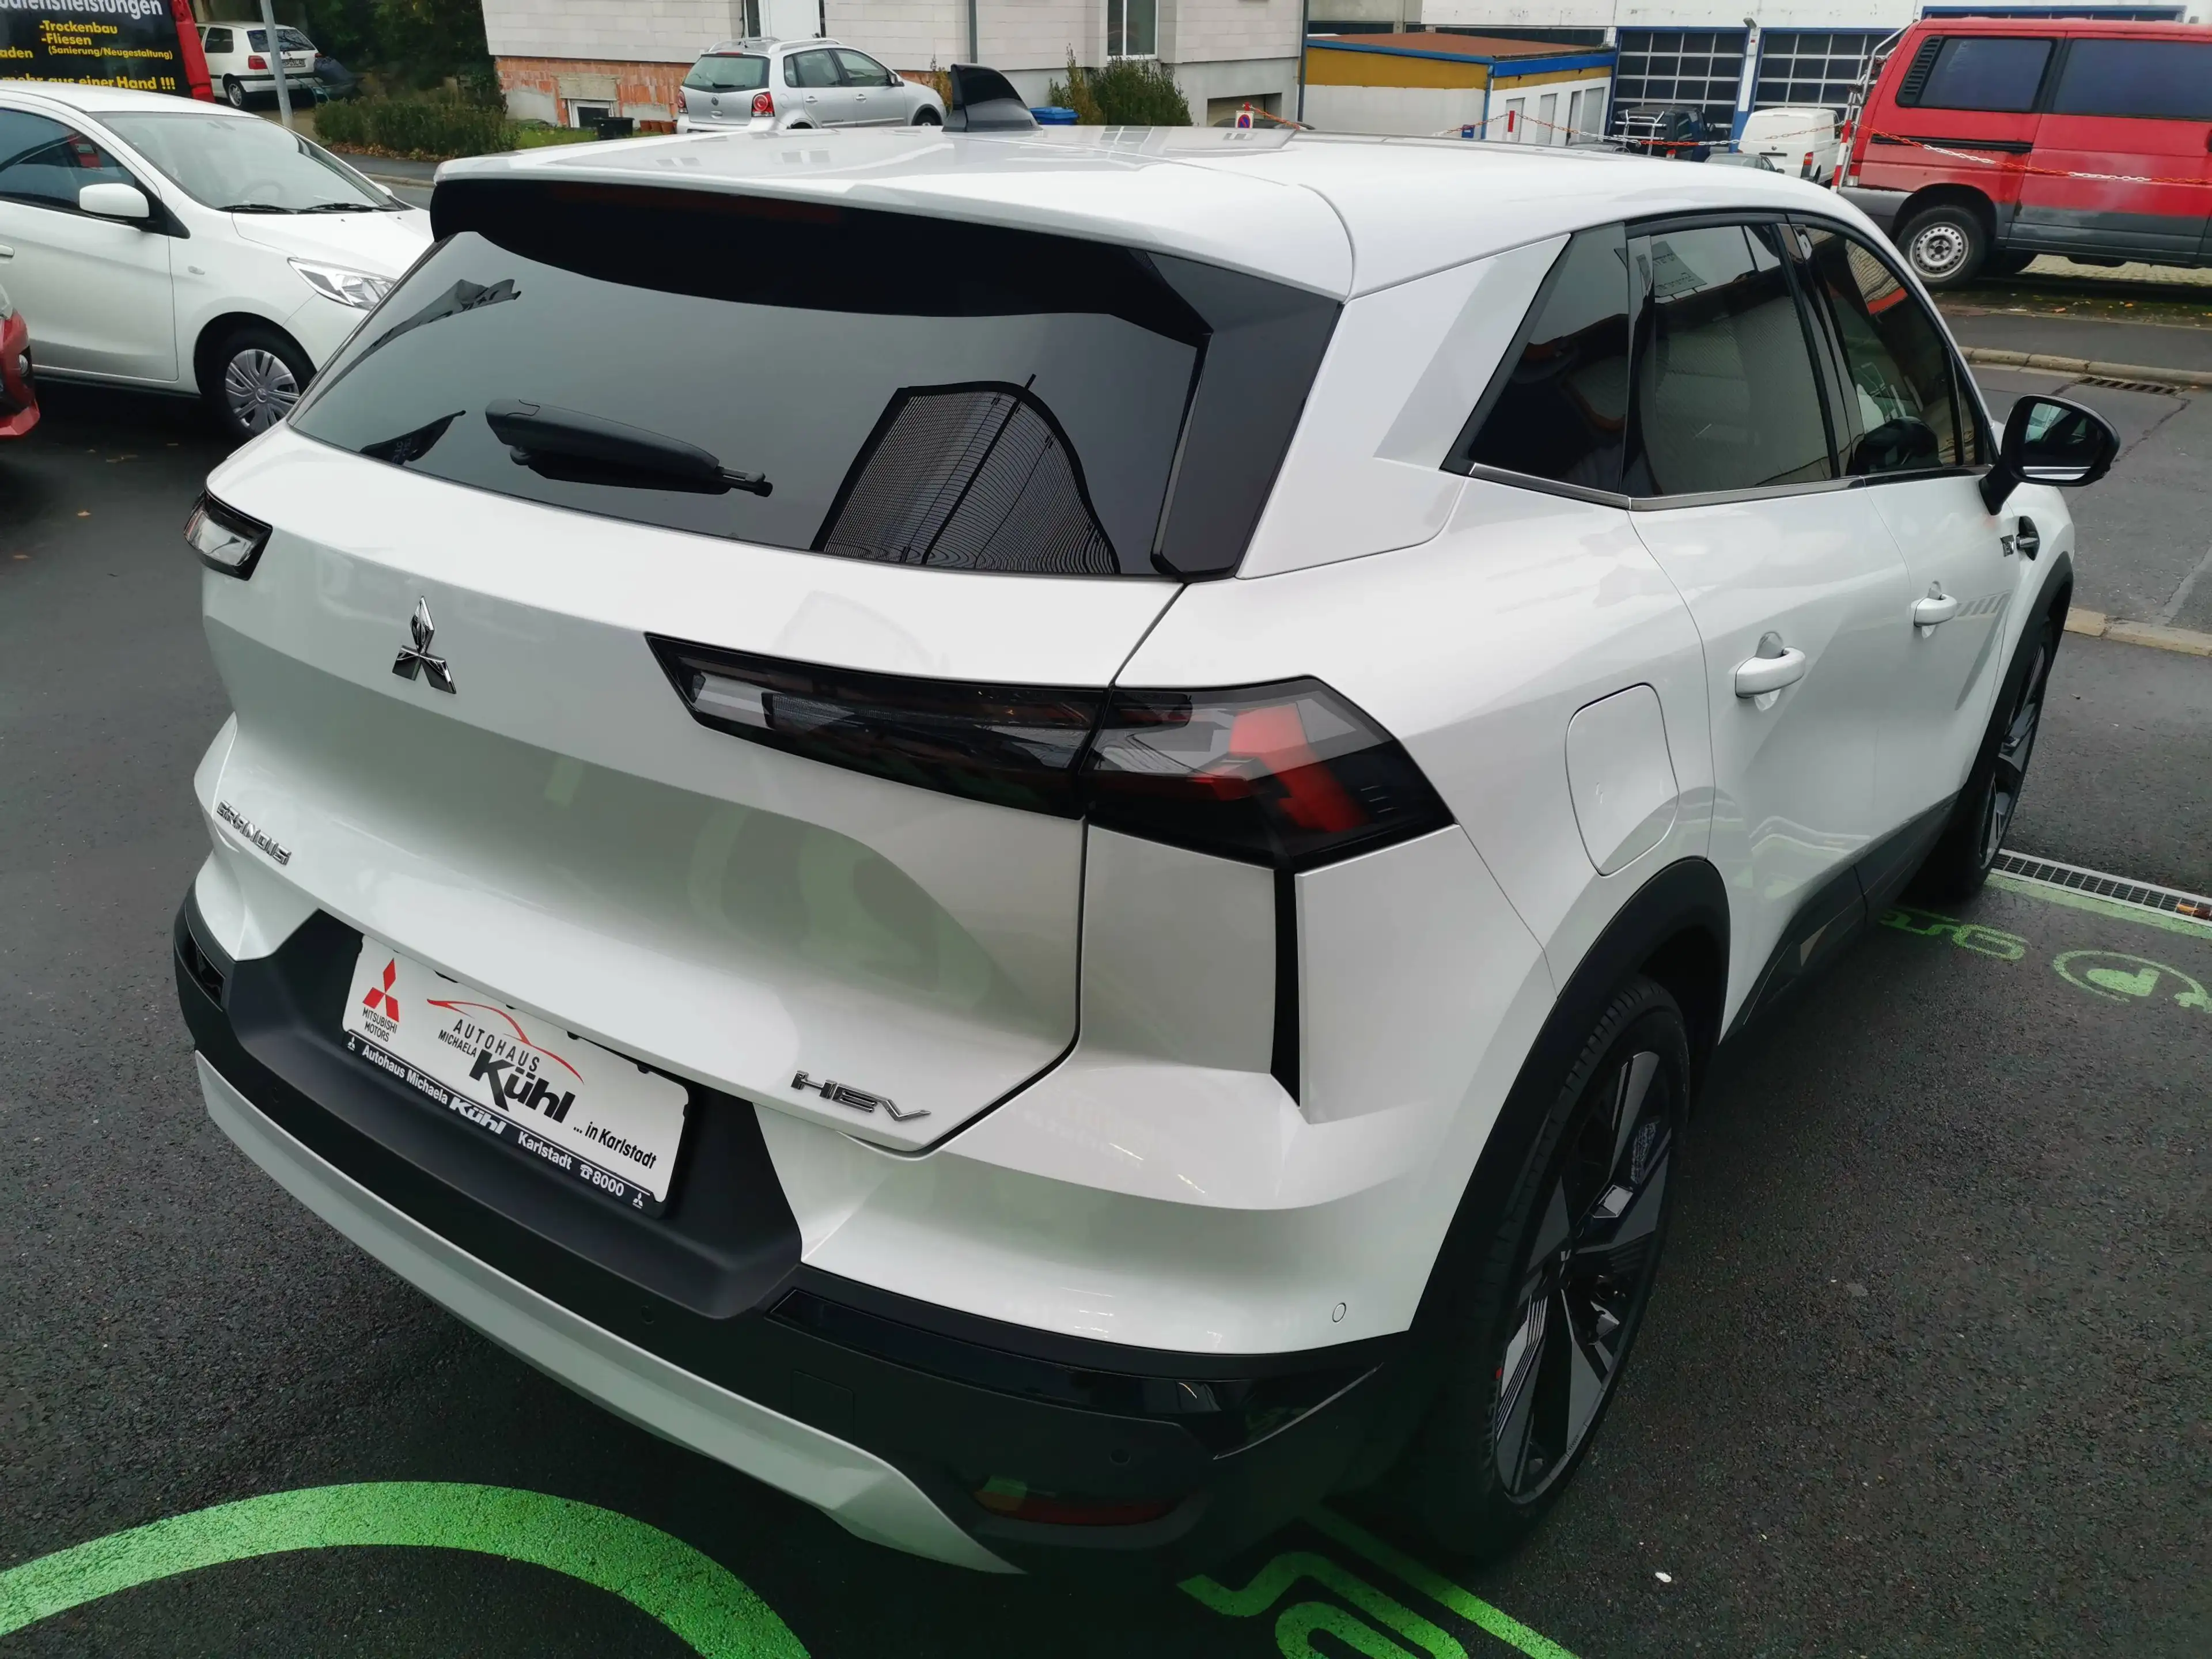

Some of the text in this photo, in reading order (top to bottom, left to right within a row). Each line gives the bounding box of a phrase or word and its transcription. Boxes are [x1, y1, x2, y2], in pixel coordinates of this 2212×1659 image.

[39, 20, 118, 34] -Trockenbau
[41, 33, 92, 46] -Fliesen
[48, 46, 173, 60] (Sanierung/Neugestaltung)
[116, 76, 157, 89] Hand
[362, 1007, 397, 1034] MITSUBISHI
[364, 1021, 389, 1042] MOTORS
[438, 1029, 477, 1057] MICHAELA
[453, 1019, 540, 1071] AUTOHAUS
[469, 1049, 575, 1123] Kühl
[790, 1070, 931, 1122] HEV
[362, 1044, 624, 1196] Autohaus Michaela Kühl Karlstadt 8000
[598, 1128, 657, 1169] Karlstadt
